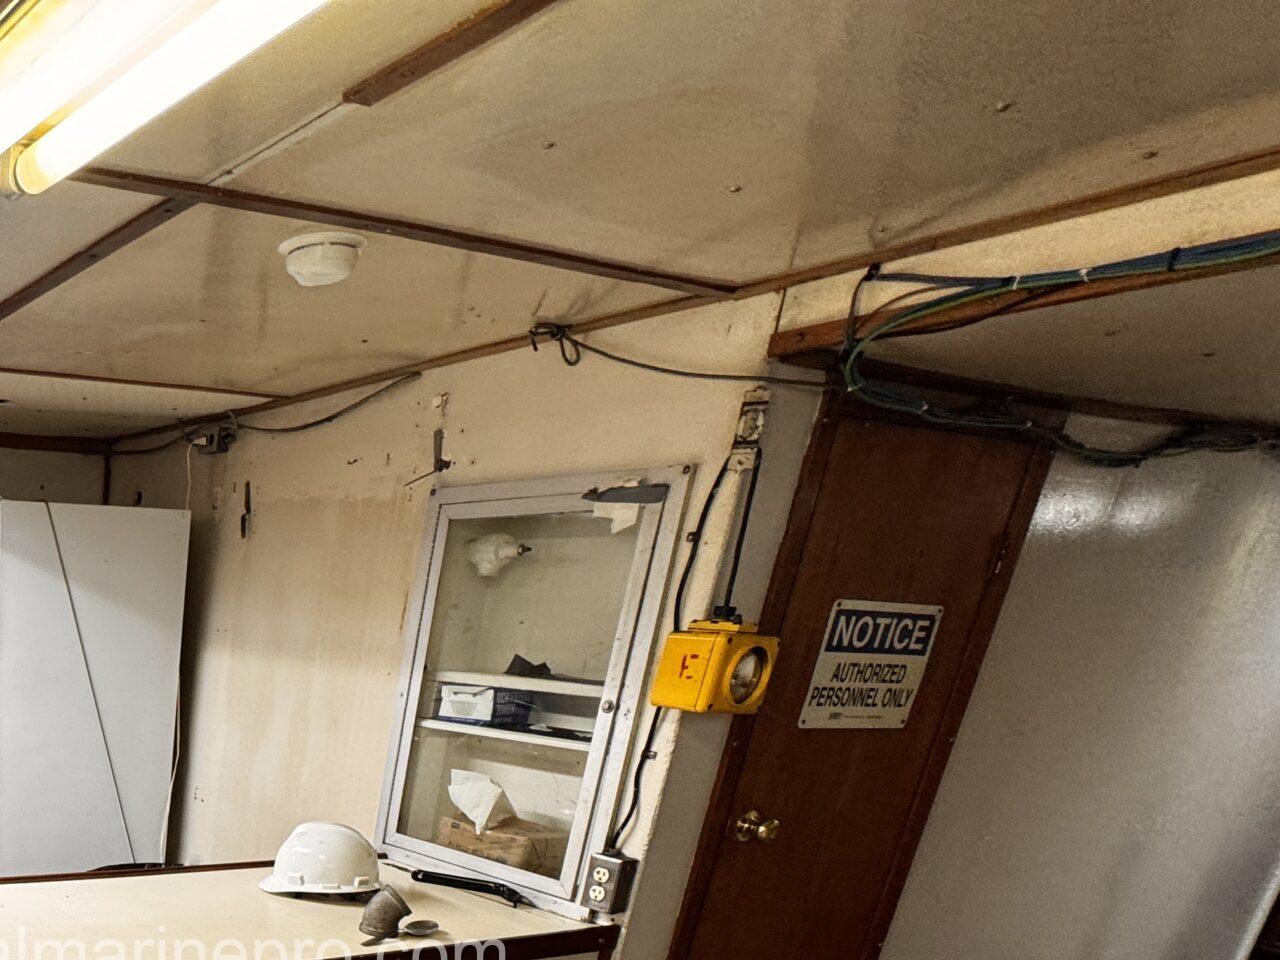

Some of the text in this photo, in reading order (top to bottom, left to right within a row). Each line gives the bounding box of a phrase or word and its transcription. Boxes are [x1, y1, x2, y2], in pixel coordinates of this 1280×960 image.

[831, 615, 930, 650] NOTICE
[830, 662, 907, 684] AUTHORIZED
[808, 686, 914, 708] PERSONNEL ONLY
